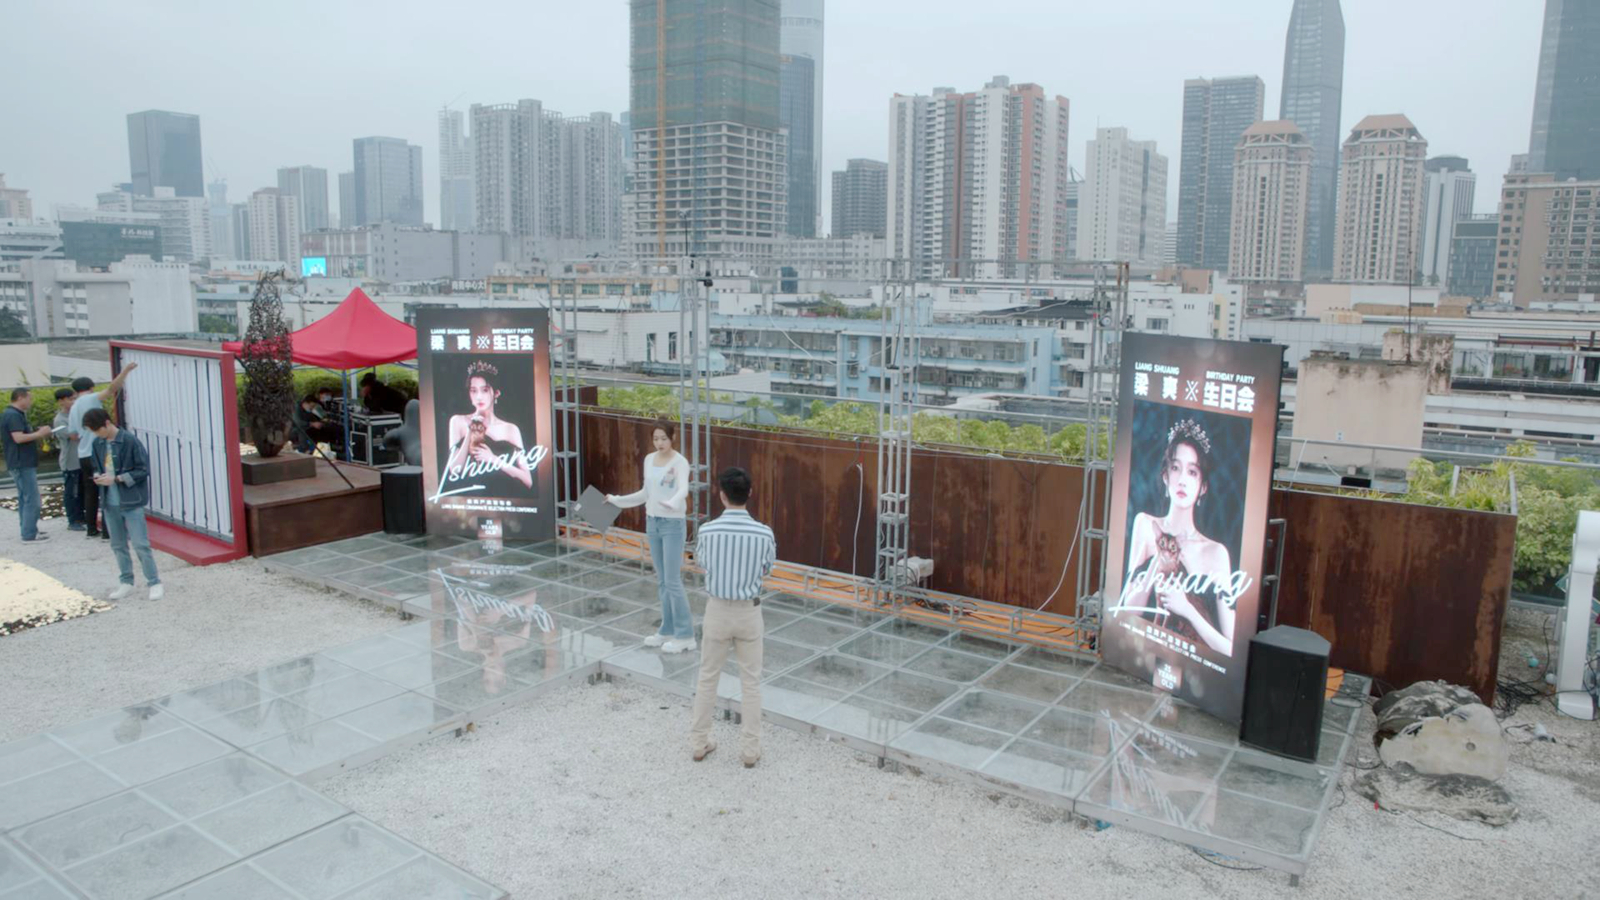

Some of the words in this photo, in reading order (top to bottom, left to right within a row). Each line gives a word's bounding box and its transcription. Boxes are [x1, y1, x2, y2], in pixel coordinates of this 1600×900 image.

[493, 335, 534, 350] 生日会
[1135, 362, 1153, 371] LIANG
[1154, 364, 1180, 375] SHUANG
[1206, 371, 1235, 382] BIRTHDAY
[1235, 374, 1255, 384] PARTY
[1203, 381, 1255, 413] 生日会
